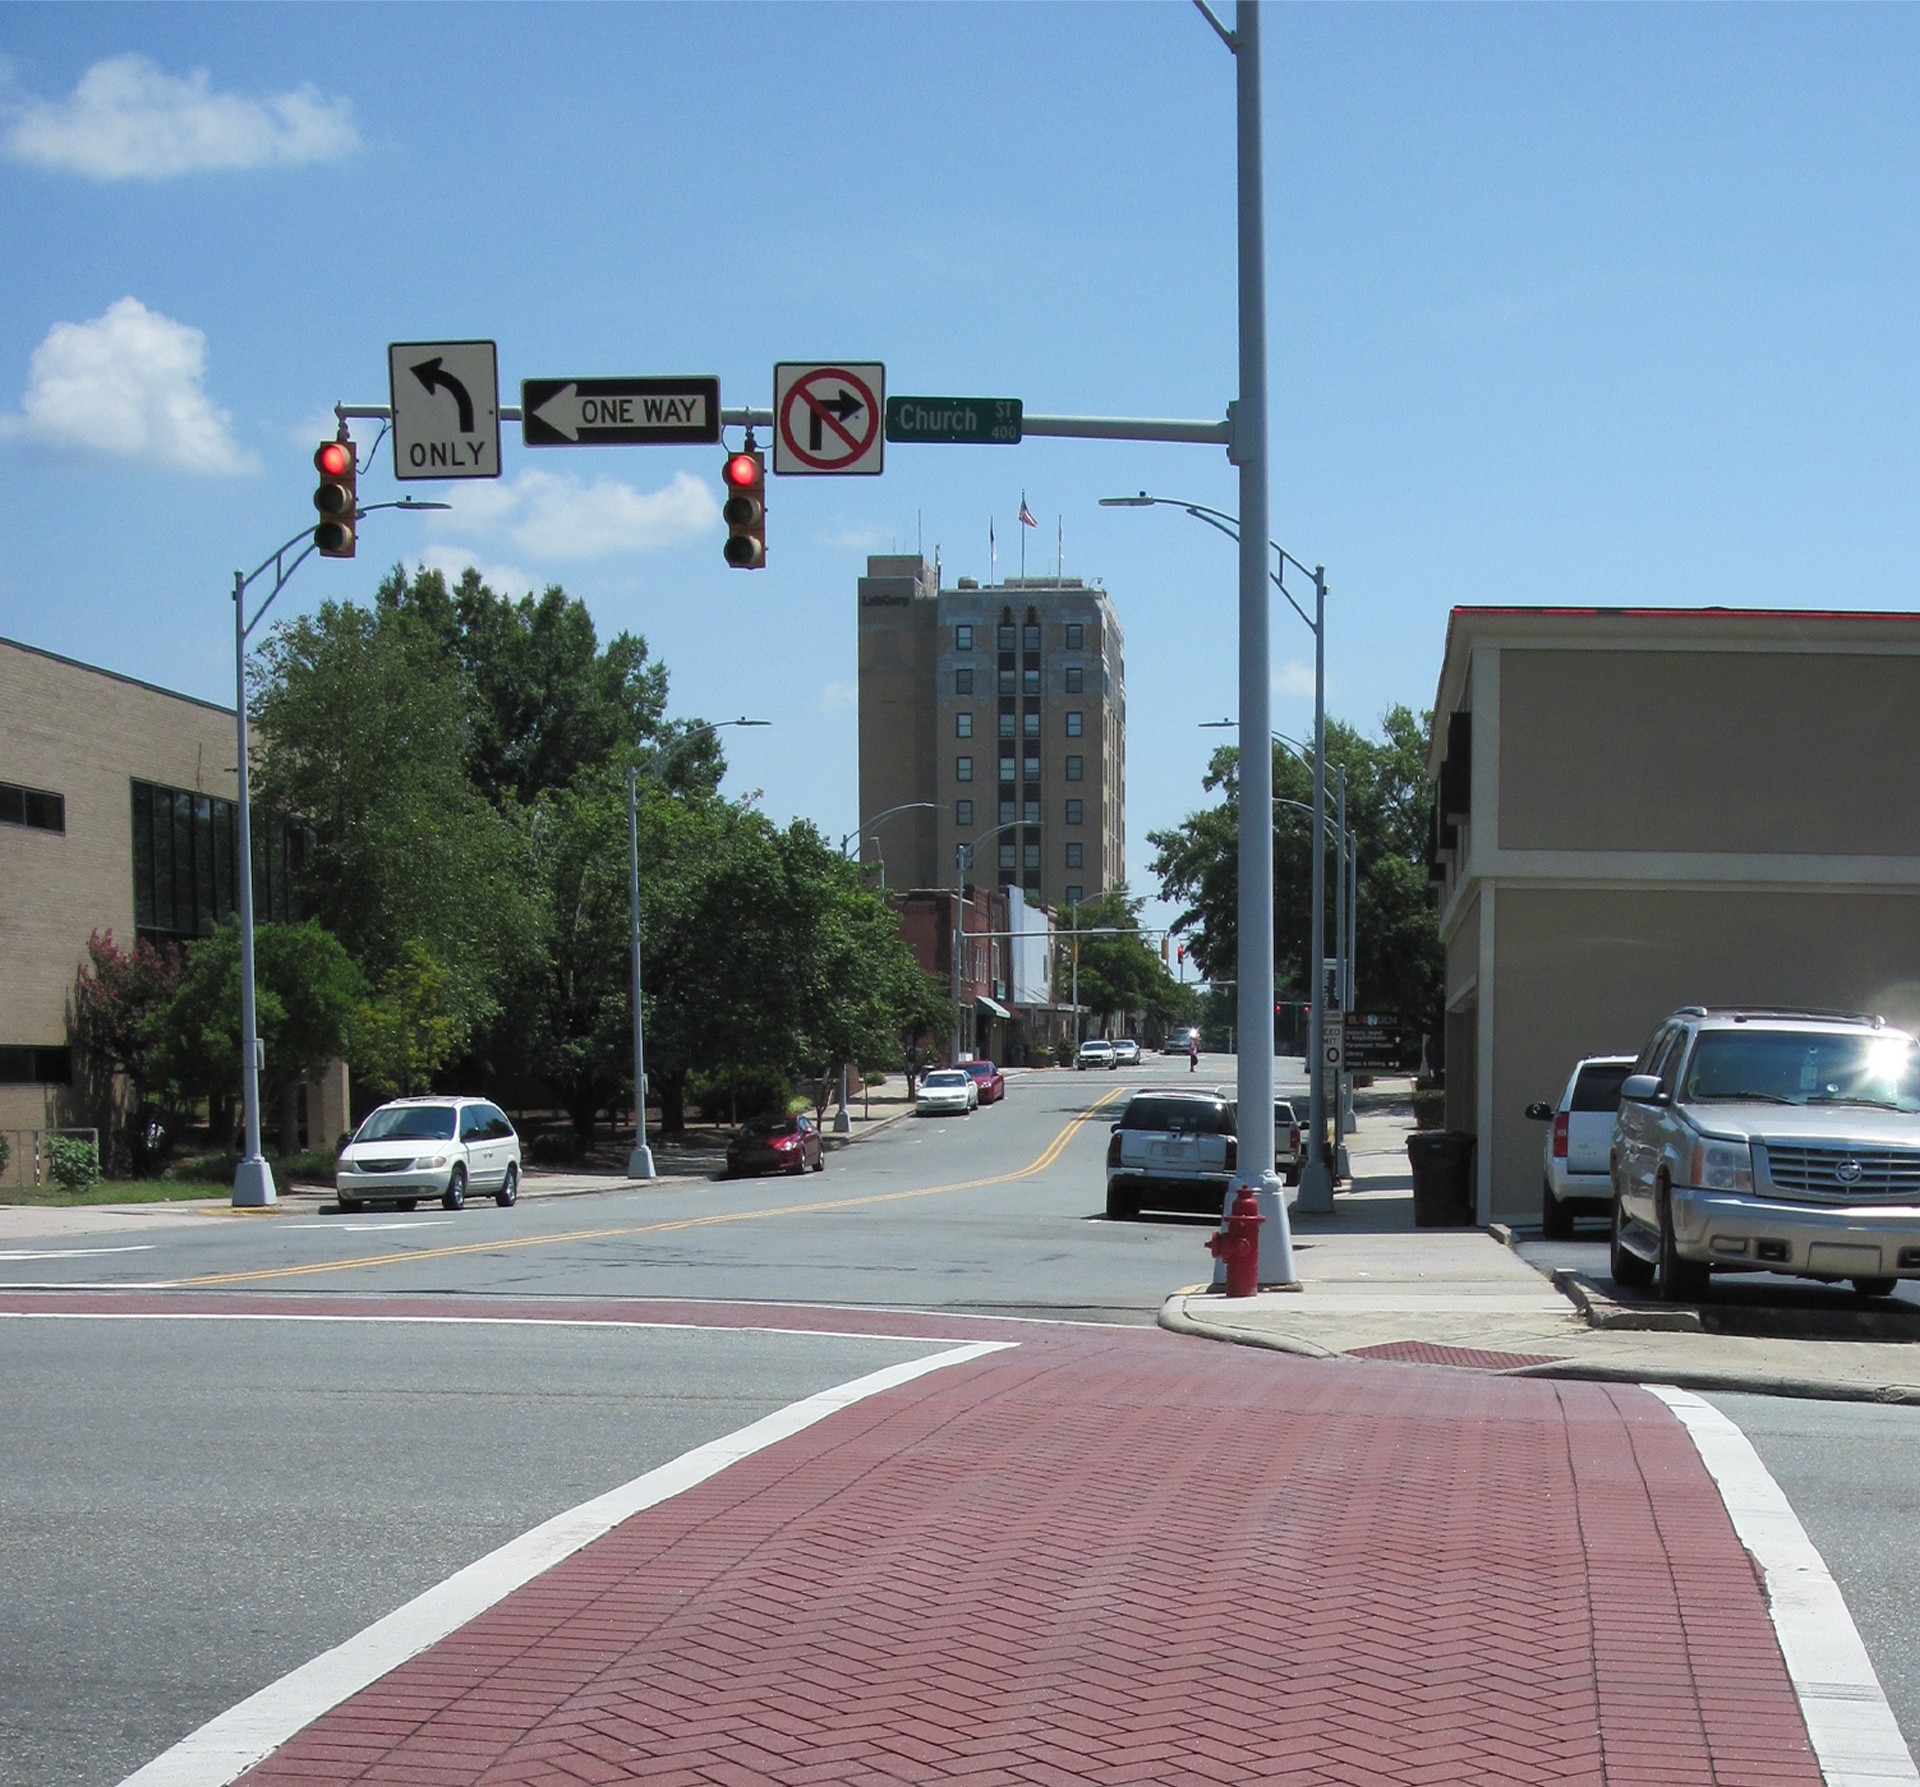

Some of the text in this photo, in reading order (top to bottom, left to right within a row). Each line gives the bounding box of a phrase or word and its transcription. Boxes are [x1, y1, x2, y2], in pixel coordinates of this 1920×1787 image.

[582, 398, 697, 424] ONE WAY
[900, 401, 1013, 431] Church ST
[991, 425, 1017, 440] 400
[410, 441, 486, 467] ONLY
